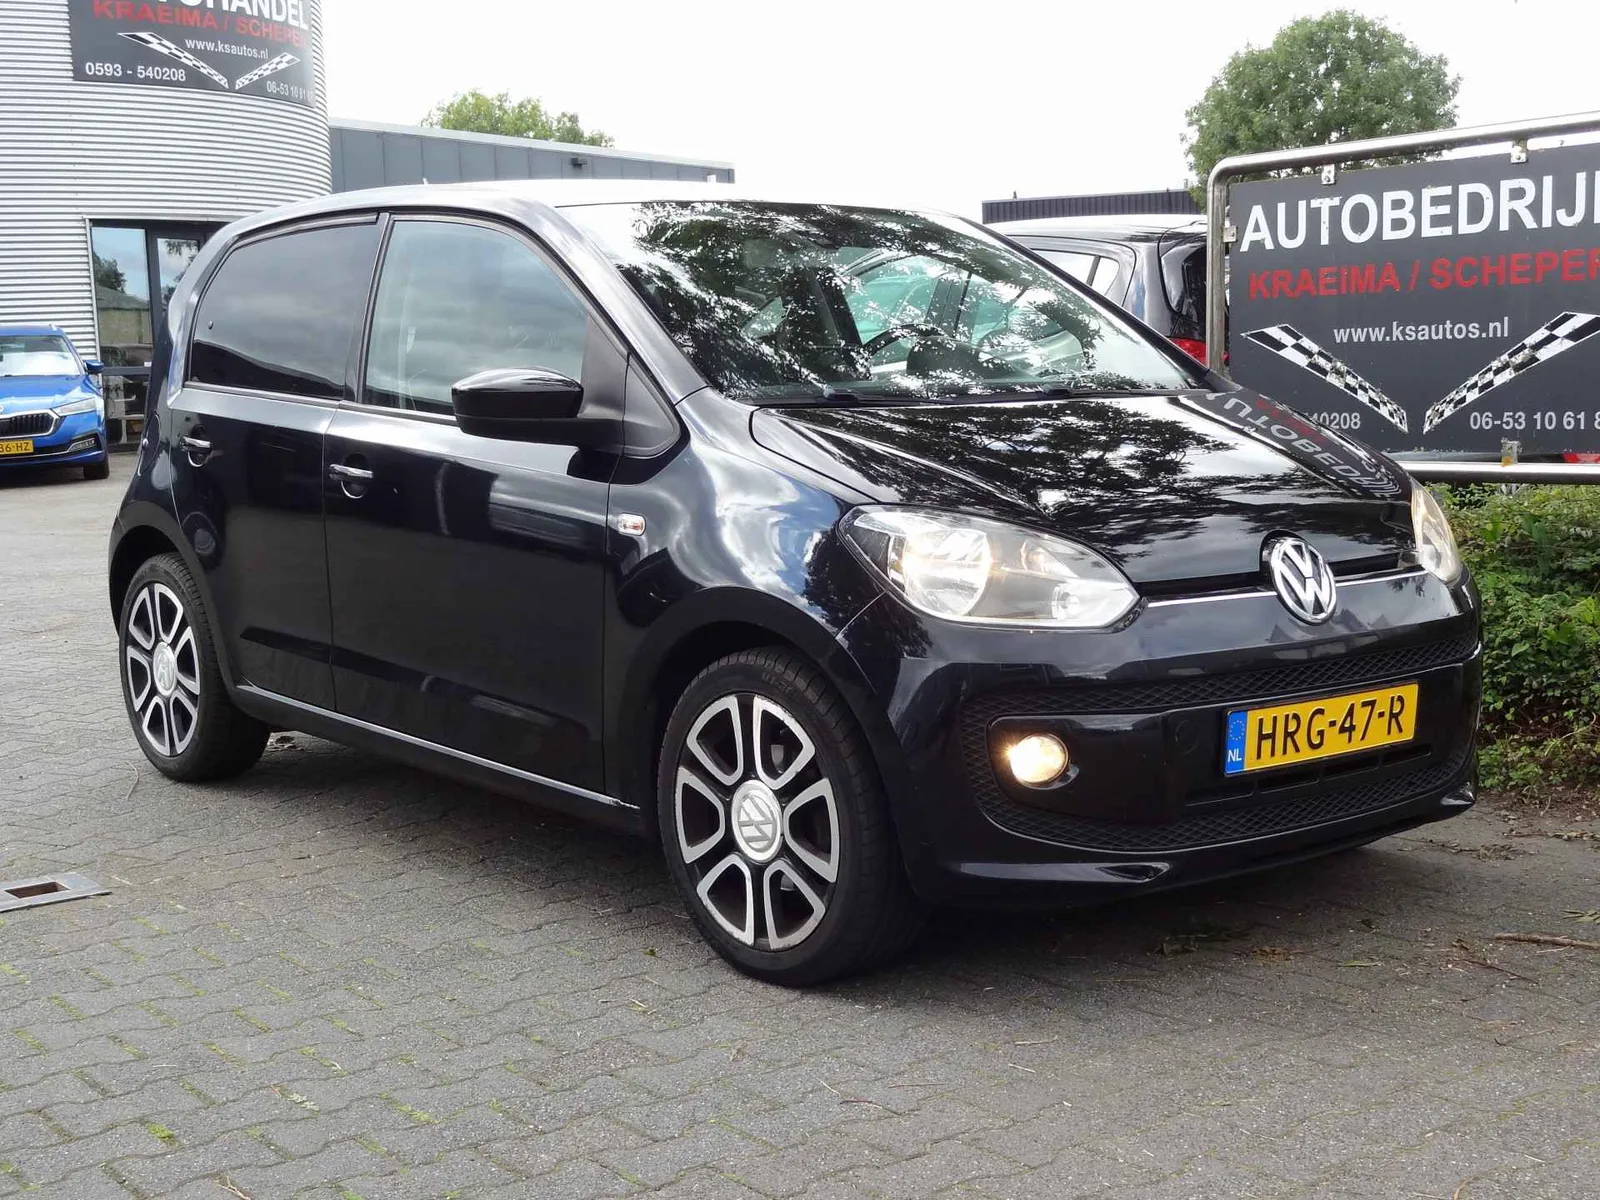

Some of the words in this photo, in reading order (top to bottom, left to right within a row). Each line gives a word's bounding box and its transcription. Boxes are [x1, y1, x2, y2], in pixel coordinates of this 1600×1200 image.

[93, 1, 219, 30] KRAEIMA
[184, 38, 269, 60] www.ksautos.nl
[85, 62, 122, 78] 0593
[137, 66, 186, 82] 540208
[266, 80, 289, 96] 06-53
[1240, 170, 1600, 252] AUTOBEDRIJ
[1250, 262, 1399, 300] KRAEIMA
[1333, 316, 1509, 344] www.ksautos.nl
[1304, 412, 1361, 430] 0208
[1469, 411, 1526, 430] 06-53
[1533, 411, 1557, 430] 10
[1563, 411, 1585, 430] 61
[1256, 694, 1405, 760] HRG-47-R
[1227, 749, 1242, 763] NL
